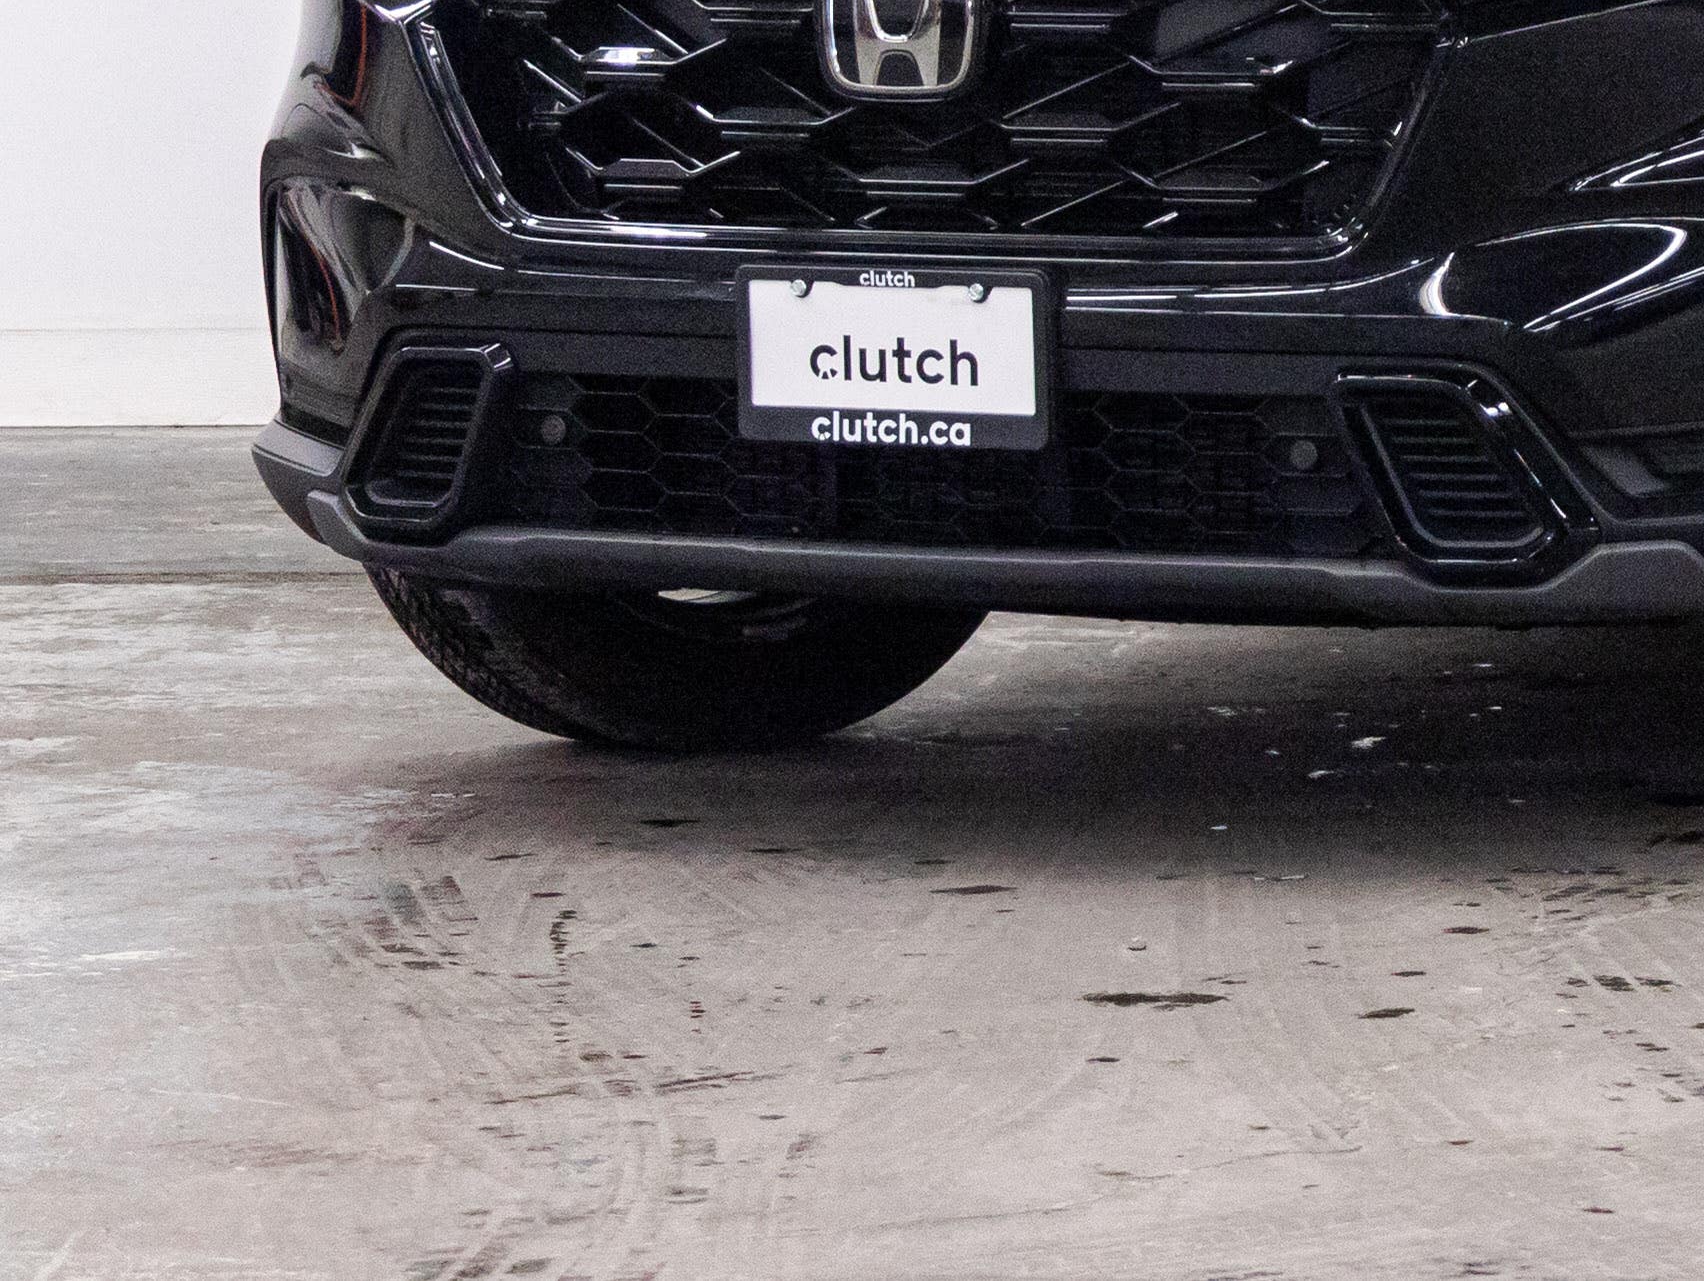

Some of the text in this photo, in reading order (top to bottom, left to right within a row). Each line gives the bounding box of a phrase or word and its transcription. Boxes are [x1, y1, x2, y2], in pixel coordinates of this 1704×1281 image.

[859, 270, 915, 288] clutch
[809, 334, 979, 386] clutch
[811, 410, 971, 446] clutch.ca
